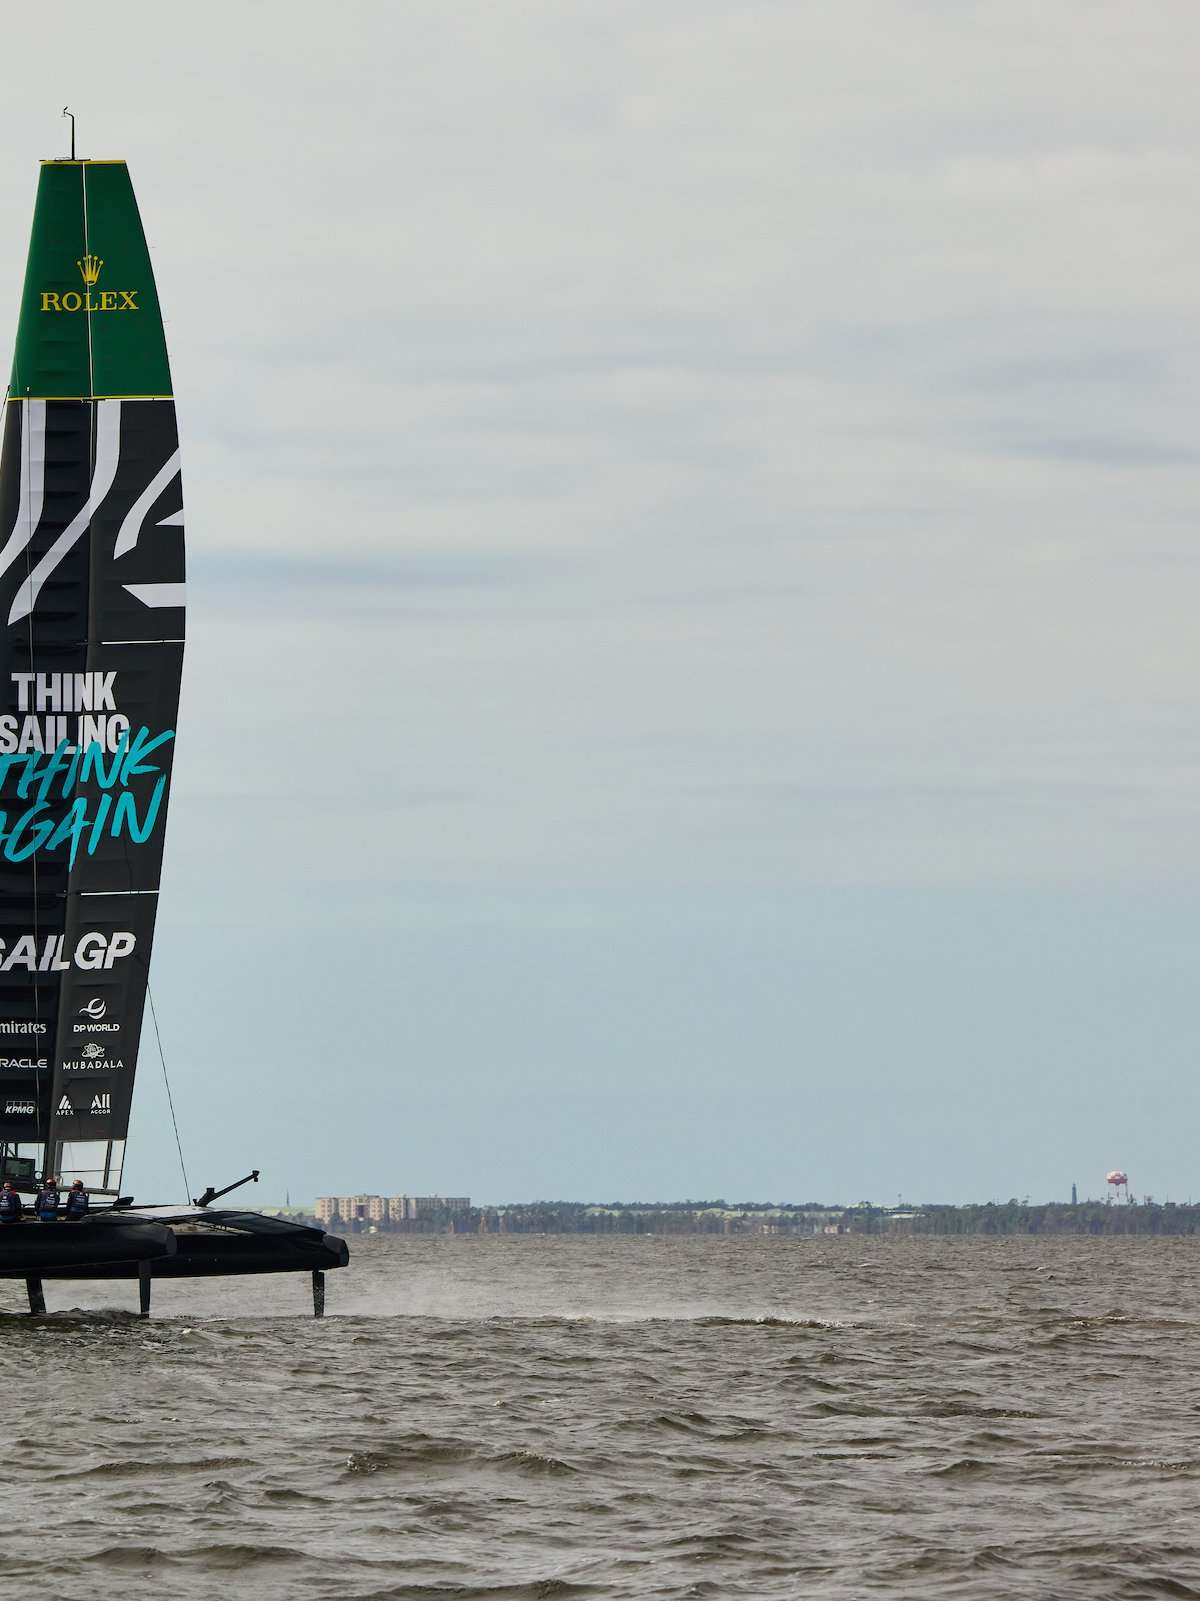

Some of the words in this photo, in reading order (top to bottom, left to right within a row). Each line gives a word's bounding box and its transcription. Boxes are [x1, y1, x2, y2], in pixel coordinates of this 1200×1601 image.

[40, 291, 139, 311] ROLEX
[11, 671, 117, 712] THINK
[86, 1023, 120, 1032] WORLD
[63, 1060, 124, 1070] MUBADALA
[5, 1105, 34, 1114] KPMG
